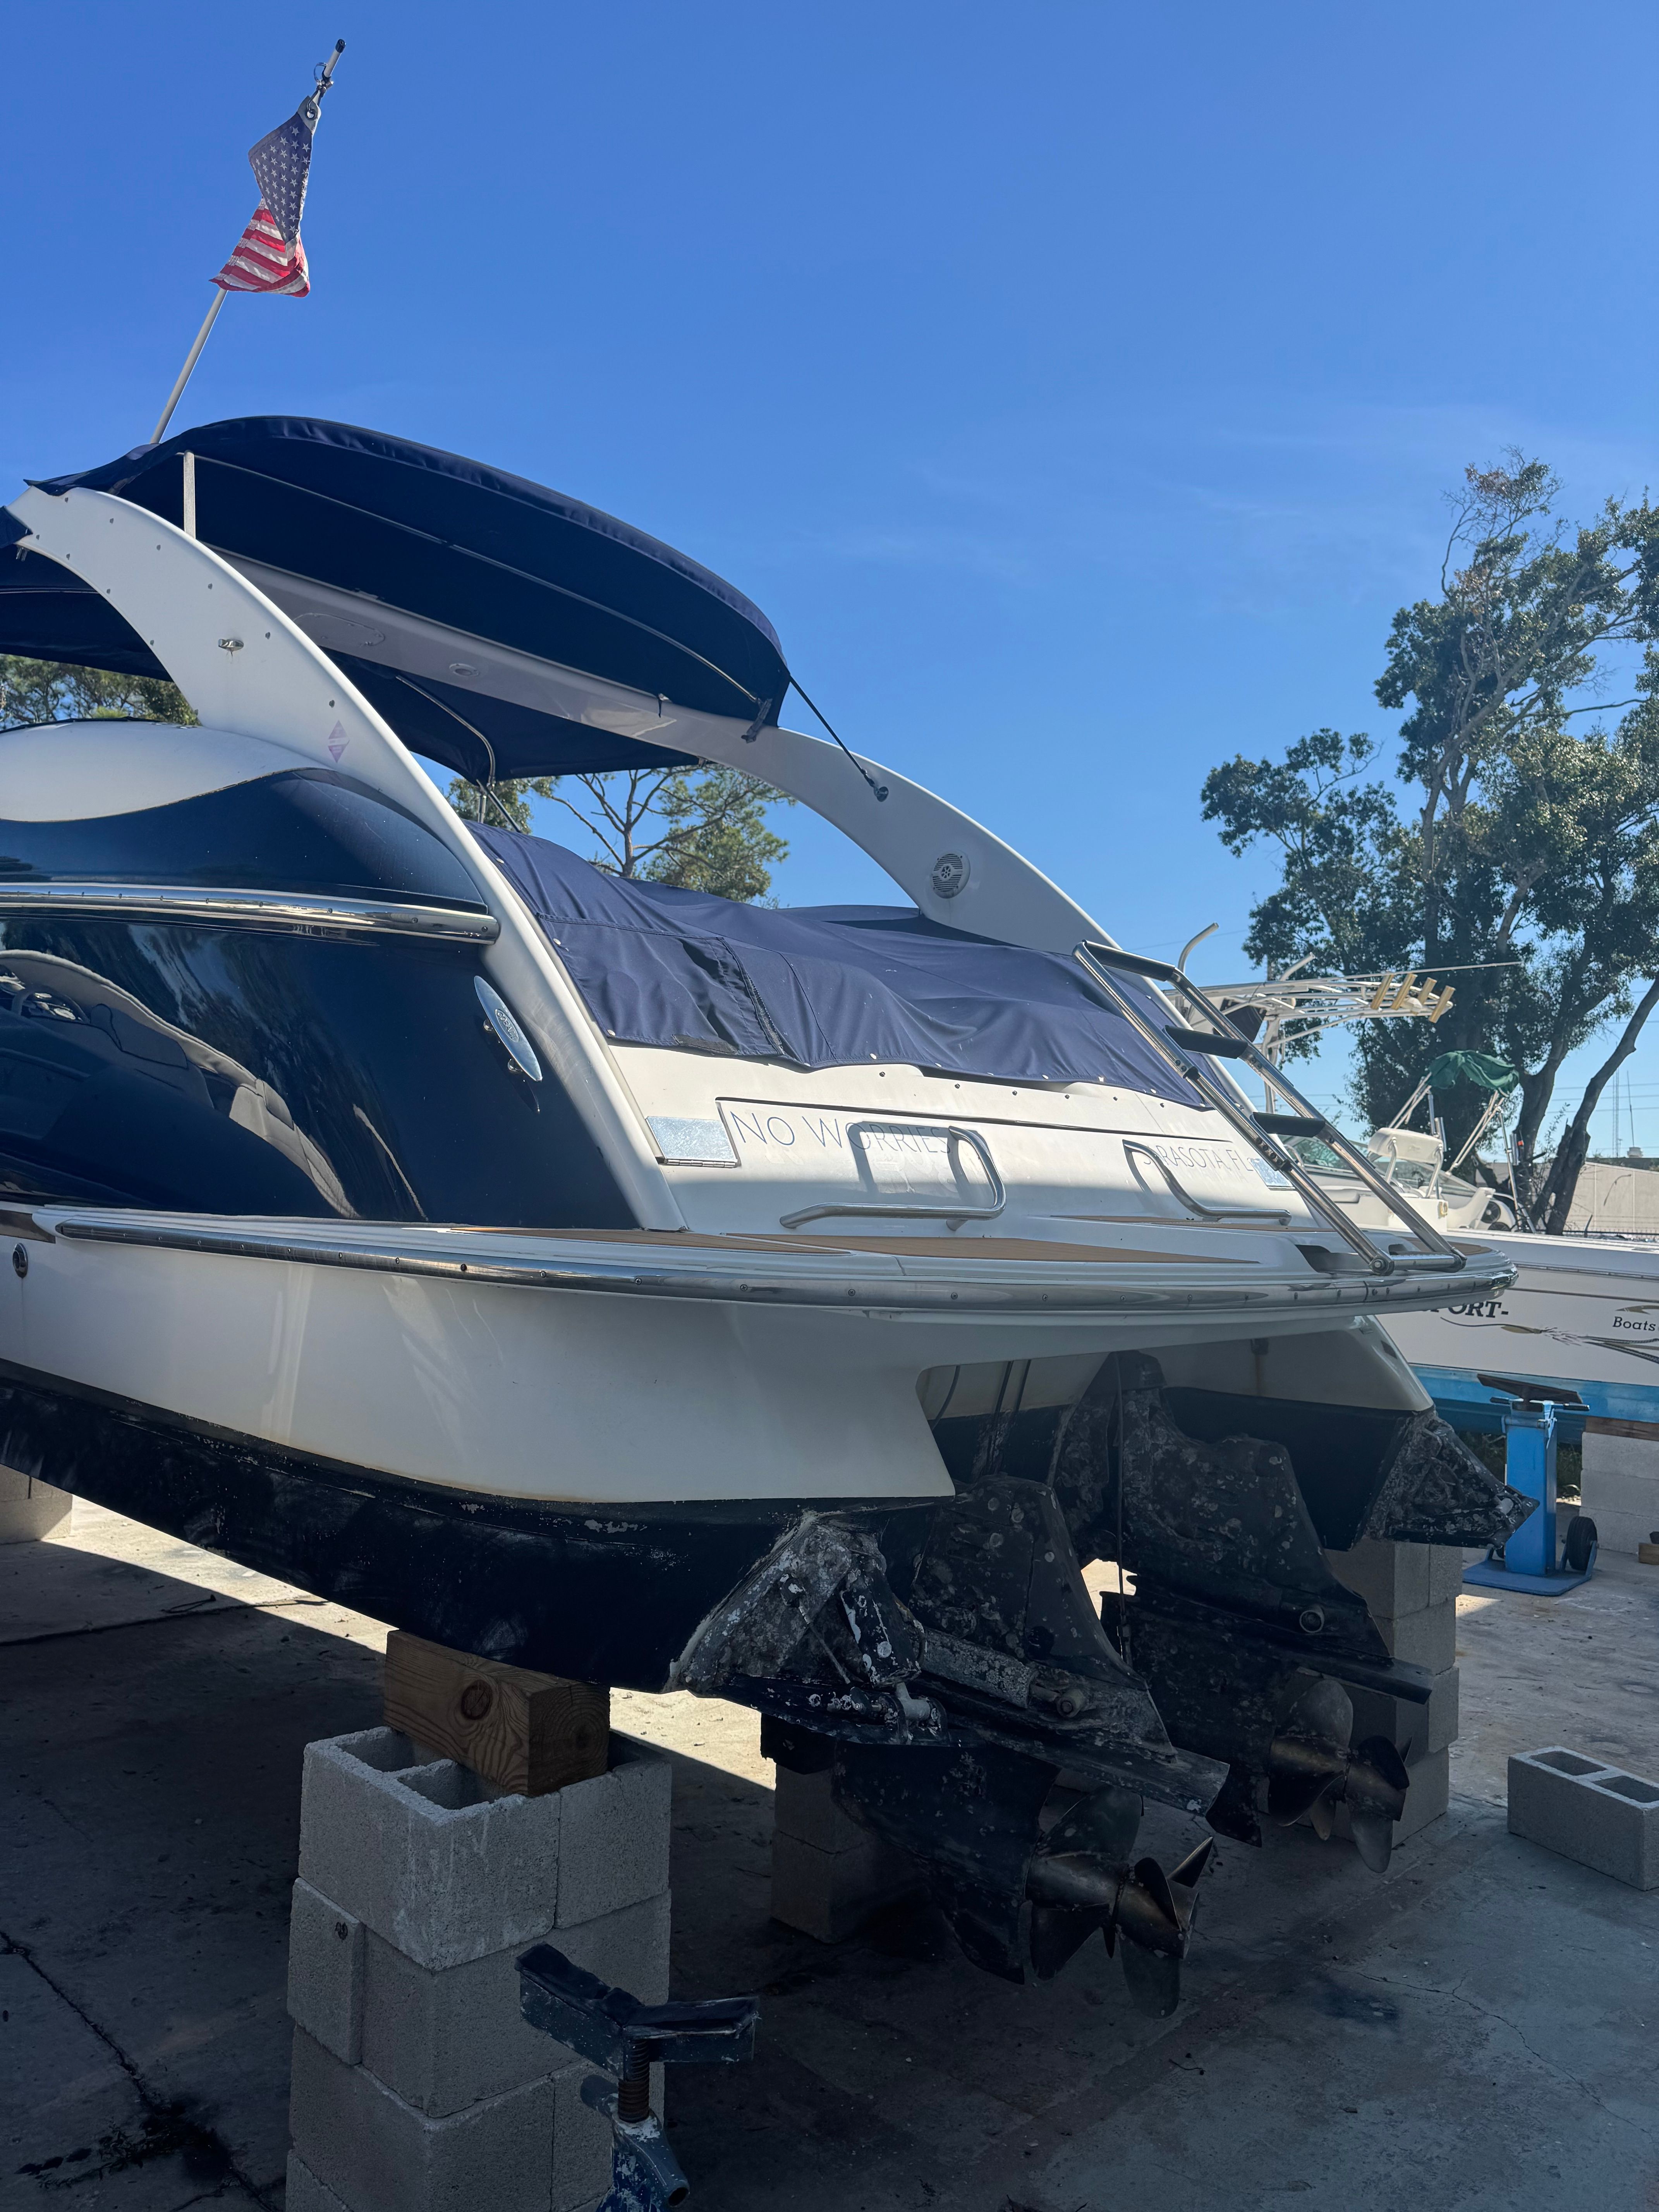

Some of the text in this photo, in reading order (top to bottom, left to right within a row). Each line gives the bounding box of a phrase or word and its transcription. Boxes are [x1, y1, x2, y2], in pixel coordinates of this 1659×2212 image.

[498, 1012, 518, 1039] COBALT
[730, 1111, 951, 1154] NO WORRIES
[1226, 1149, 1254, 1171] FL
[1613, 1316, 1656, 1331] Boats
